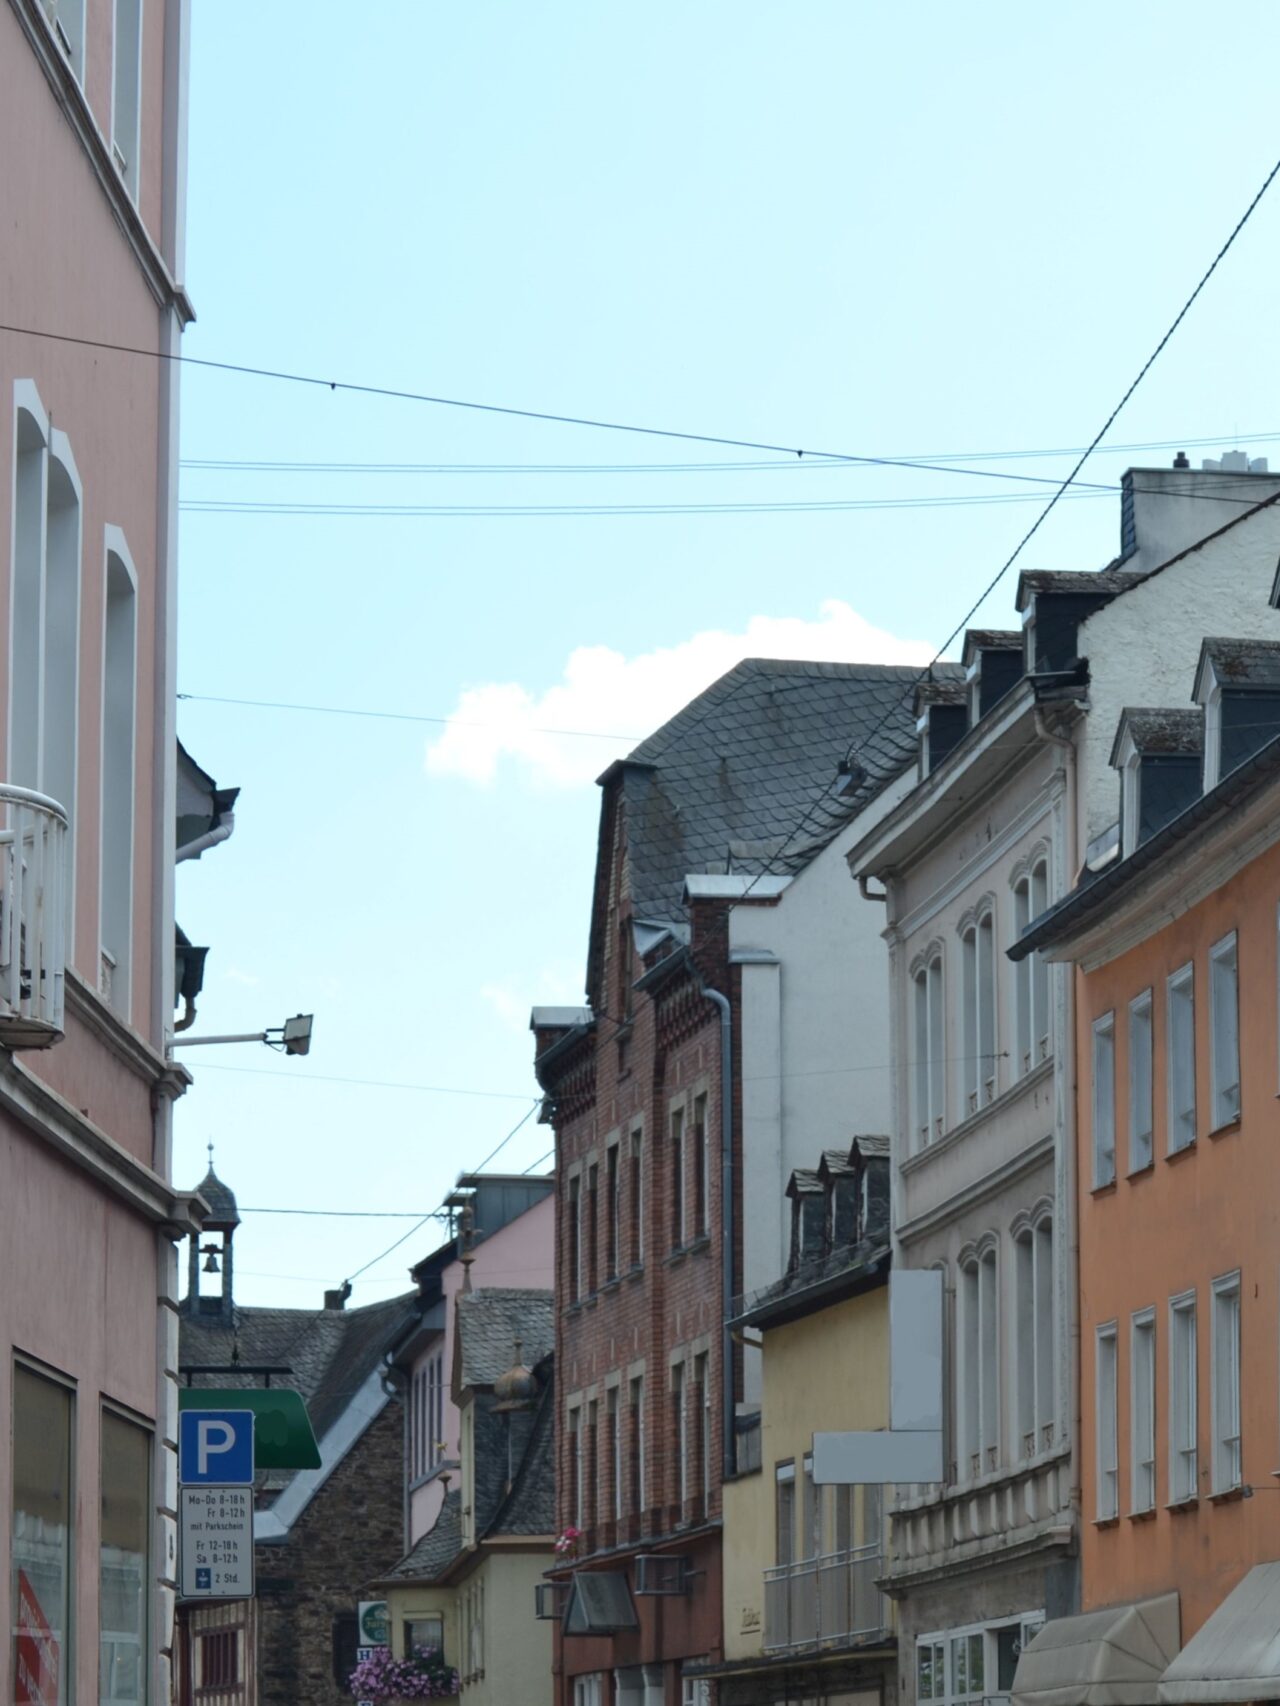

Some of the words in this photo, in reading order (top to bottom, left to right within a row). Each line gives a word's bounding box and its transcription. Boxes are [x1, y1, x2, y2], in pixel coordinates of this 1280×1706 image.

[198, 1420, 236, 1474] P
[189, 1495, 216, 1505] Mo-Do
[207, 1508, 216, 1518] Fr
[190, 1522, 202, 1531] mit
[205, 1521, 244, 1531] Parkschein
[196, 1541, 205, 1550] Fr
[197, 1554, 206, 1563] Sa
[215, 1574, 221, 1584] 2
[224, 1573, 240, 1584] Std.
